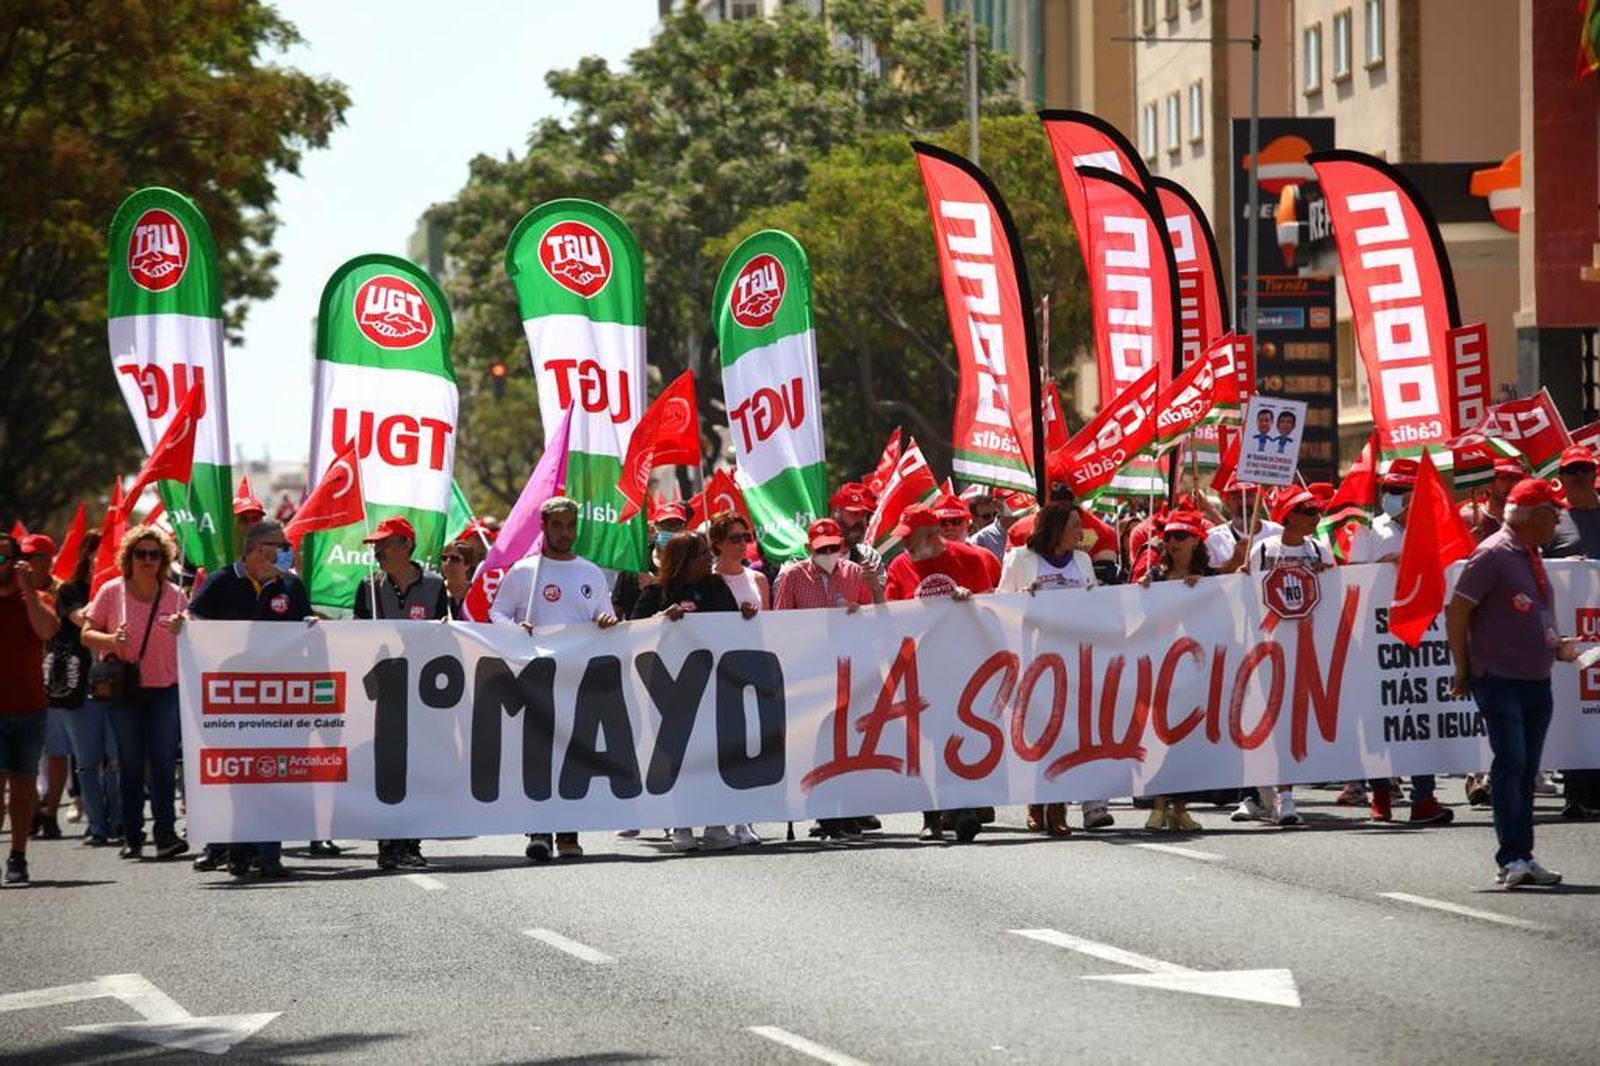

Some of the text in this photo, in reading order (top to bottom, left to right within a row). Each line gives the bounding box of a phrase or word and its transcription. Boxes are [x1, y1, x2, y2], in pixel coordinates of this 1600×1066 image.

[366, 285, 423, 314] UGT
[331, 407, 454, 471] UGT
[208, 680, 311, 705] CCOO
[801, 583, 1361, 794] LA SOLUCIÓN
[1381, 671, 1428, 706] MÁS
[203, 717, 345, 731] unión provincial de Cádiz
[1383, 708, 1431, 743] MÁS
[206, 756, 254, 778] UGT
[289, 753, 343, 766] Andalucía
